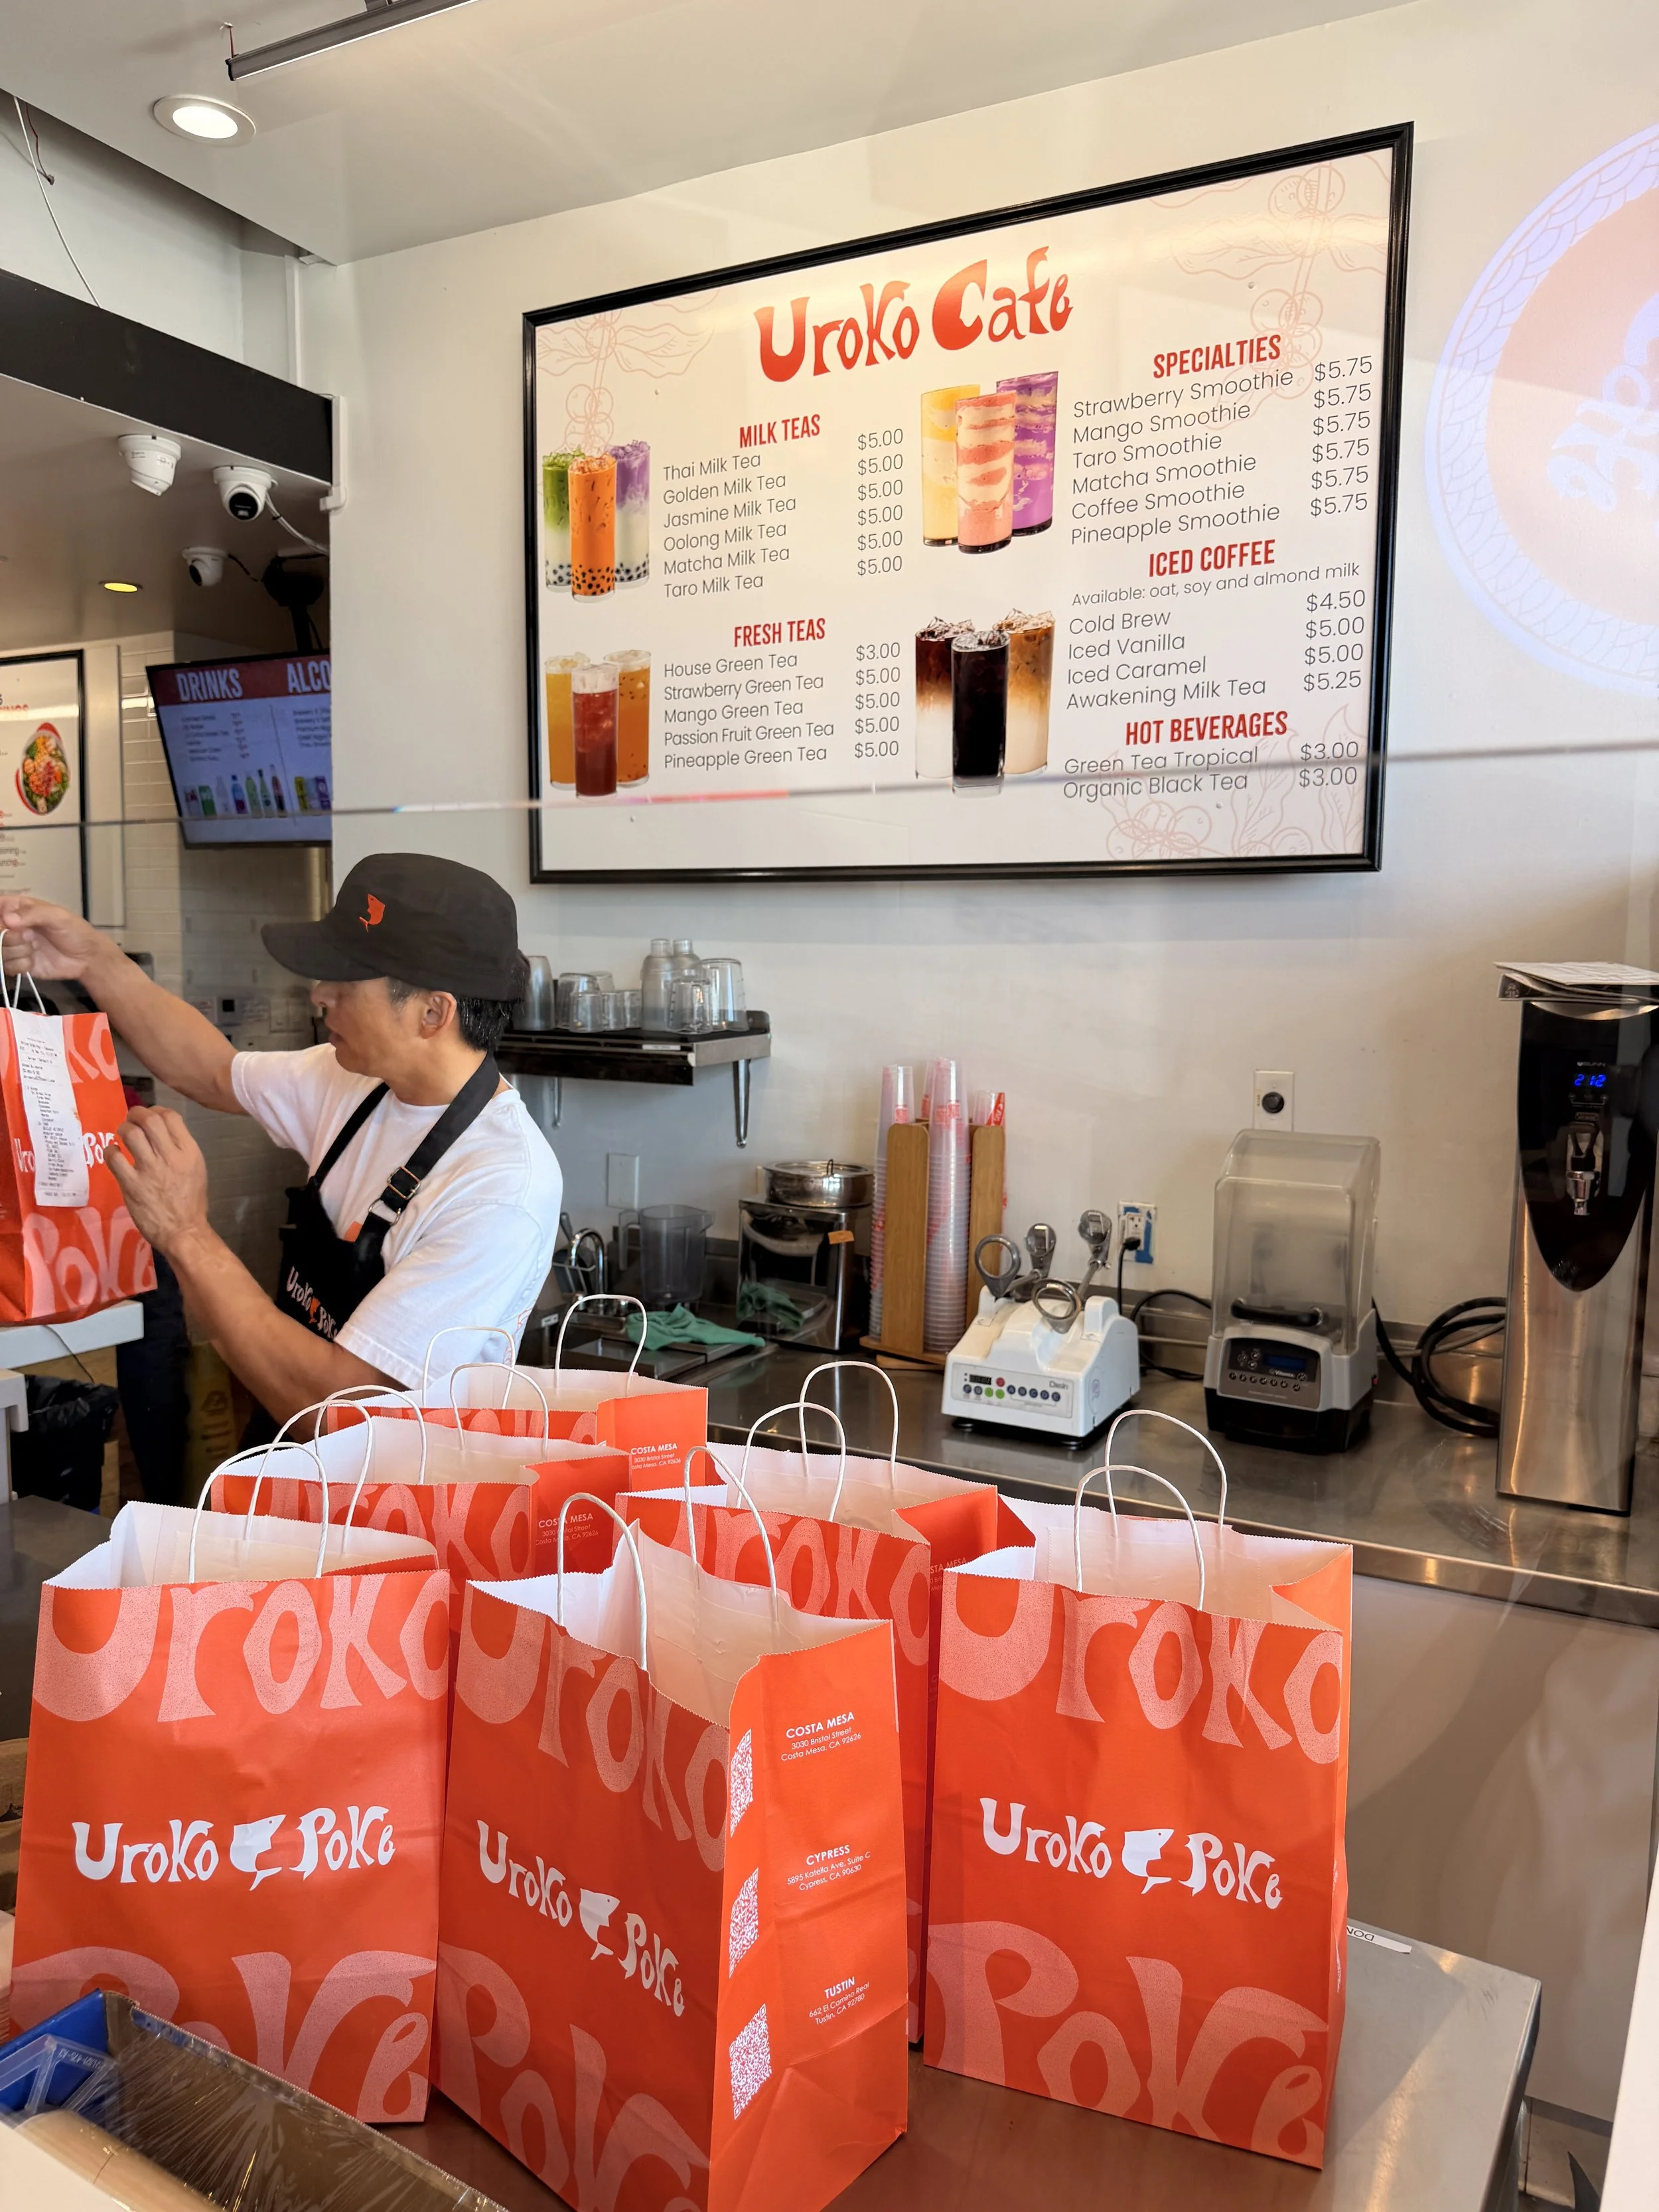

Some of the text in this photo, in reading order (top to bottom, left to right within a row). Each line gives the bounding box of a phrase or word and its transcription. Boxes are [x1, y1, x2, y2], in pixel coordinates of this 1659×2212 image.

[932, 246, 1073, 350] Cafe
[1153, 334, 1281, 379] SPECIALTIES
[1315, 355, 1372, 383] $5.75
[1074, 368, 1293, 418] Strawberry Smoothie
[1313, 382, 1372, 410] $5.75
[739, 413, 821, 449] MILK TEAS
[1073, 402, 1253, 444] Mango Smoothie
[1313, 410, 1370, 437] $5.75
[857, 428, 903, 452] $5.00
[1072, 432, 1222, 469] Taro Smoothie
[1312, 437, 1370, 465] $5.75
[663, 454, 761, 481] Thai Milk Tea
[857, 453, 903, 477] $5.00
[1072, 454, 1257, 494] Matcha Smoothie
[1311, 465, 1369, 491] $5.75
[663, 475, 786, 504] Golden Milk Tea
[857, 479, 903, 502] $5.00
[1072, 481, 1245, 520] Coffee Smoothie
[663, 498, 796, 528] Jasmine Milk Tea
[857, 504, 903, 526] $5.00
[1310, 492, 1368, 518] $5.75
[1072, 503, 1280, 546] Pineapple Smoothie
[663, 524, 786, 552] Oolong Milk Tea
[857, 530, 903, 552] $5.00
[664, 548, 790, 575] Matcha Milk Tea
[857, 555, 902, 577] $5.00
[1149, 538, 1276, 578] ICED COFFEE
[664, 575, 763, 598] Taro Milk Tea
[1072, 562, 1360, 607] Available: oat, soy and almond milk
[1306, 589, 1366, 614] $4.50
[734, 617, 826, 648] FRESH TEAS
[1069, 611, 1171, 634] Cold Brew
[1305, 616, 1364, 640] $5.00
[855, 642, 901, 662] $3.00
[1068, 632, 1185, 660] Iced Vanilla
[1304, 643, 1364, 667] $5.00
[664, 654, 798, 678] House Green Tea
[855, 666, 901, 687] $5.00
[1068, 655, 1206, 685] Iced Caramel
[176, 668, 243, 701] DRINKS
[664, 675, 824, 701] Strawberry Green Tea
[1066, 679, 1266, 709] Awakening Milk Tea
[1303, 670, 1362, 694] $5.25
[664, 700, 803, 726] Mango Green Tea
[855, 691, 901, 711] $5.00
[664, 722, 834, 747] Passion Fruit Green Tea
[855, 715, 900, 735] $5.00
[1125, 710, 1289, 746] HOT BEVERAGES
[664, 746, 827, 772] Pineapple Green Tea
[854, 740, 899, 759] $5.00
[1063, 745, 1259, 775] Green Tea Tropical
[1300, 741, 1359, 763] $3.00
[1062, 773, 1248, 803] Organic Black Tea
[1299, 766, 1358, 788] $3.00
[631, 1443, 678, 1455] COSTA MESA
[786, 1712, 855, 1739] COSTA MESA
[791, 1727, 852, 1749] 3030 Bristol Street
[781, 1751, 804, 1761] Costa
[841, 1732, 861, 1744] 92626
[806, 1844, 850, 1866] CYPRESS
[787, 1874, 804, 1885] 5895
[804, 1866, 829, 1879] Katella
[847, 1855, 863, 1865] Suite
[841, 1864, 861, 1876] 90630
[809, 2008, 822, 2018] 662
[830, 1992, 855, 2009] Camino
[856, 1981, 869, 1994] Real
[824, 1976, 855, 1999] TUSTIN
[837, 2005, 847, 2014] CA
[847, 1993, 865, 2008] 92780
